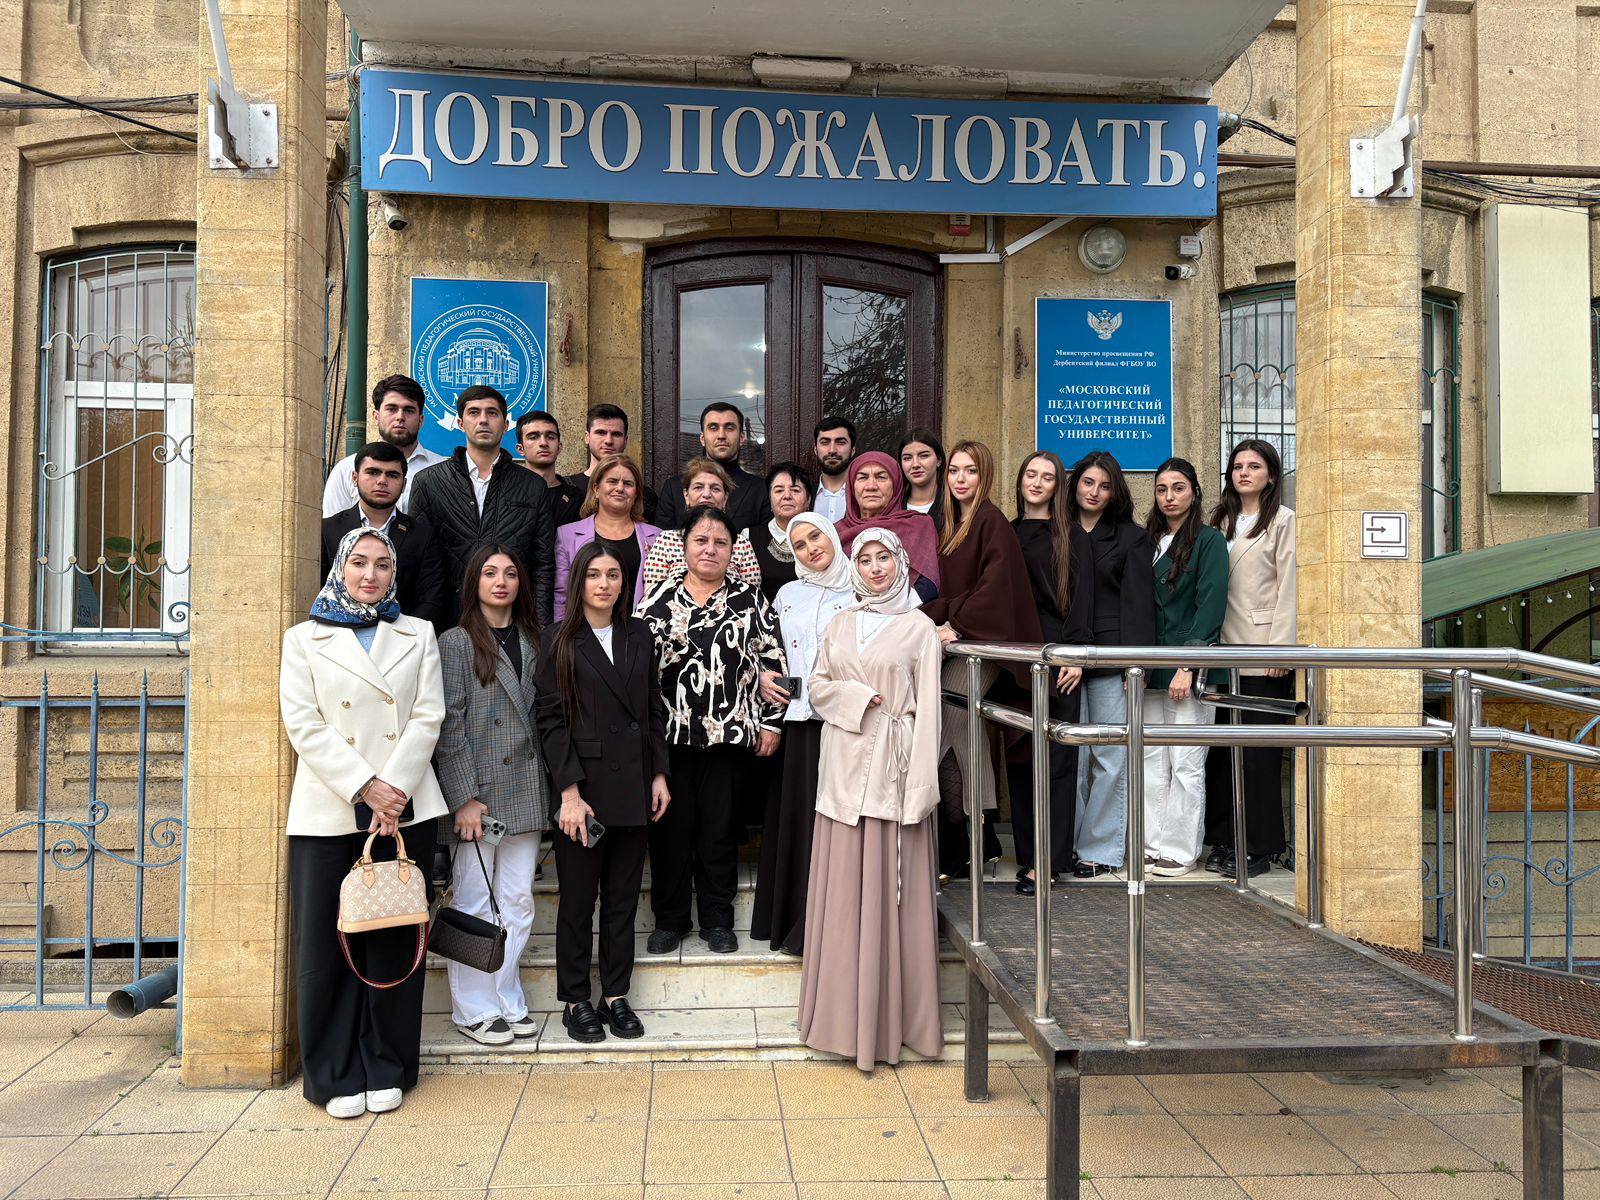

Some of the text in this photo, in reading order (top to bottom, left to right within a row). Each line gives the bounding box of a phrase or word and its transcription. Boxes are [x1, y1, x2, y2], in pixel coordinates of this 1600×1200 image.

[378, 88, 1207, 189] ДОБРО ПОЖАЛОВАТЬ!
[420, 308, 476, 354] ПЕДАГОГИЧЕСКИЙ
[477, 309, 538, 358] ГОСУДАРСТВЕННЫЙ
[519, 358, 539, 410] УНИВЕРСИТЕТ
[1055, 349, 1101, 358] Министерство
[1053, 359, 1094, 367] Дербентский
[1094, 360, 1119, 368] филиал
[1059, 384, 1151, 395] «МОСКОВСКИЙ
[1047, 399, 1162, 410] ПЕДАГОГИЧЕСКИЙ
[1044, 414, 1166, 425] ГОСУДАРСТВЕННЫЙ
[1059, 429, 1153, 440] УНИВЕРСИТЕТ»
